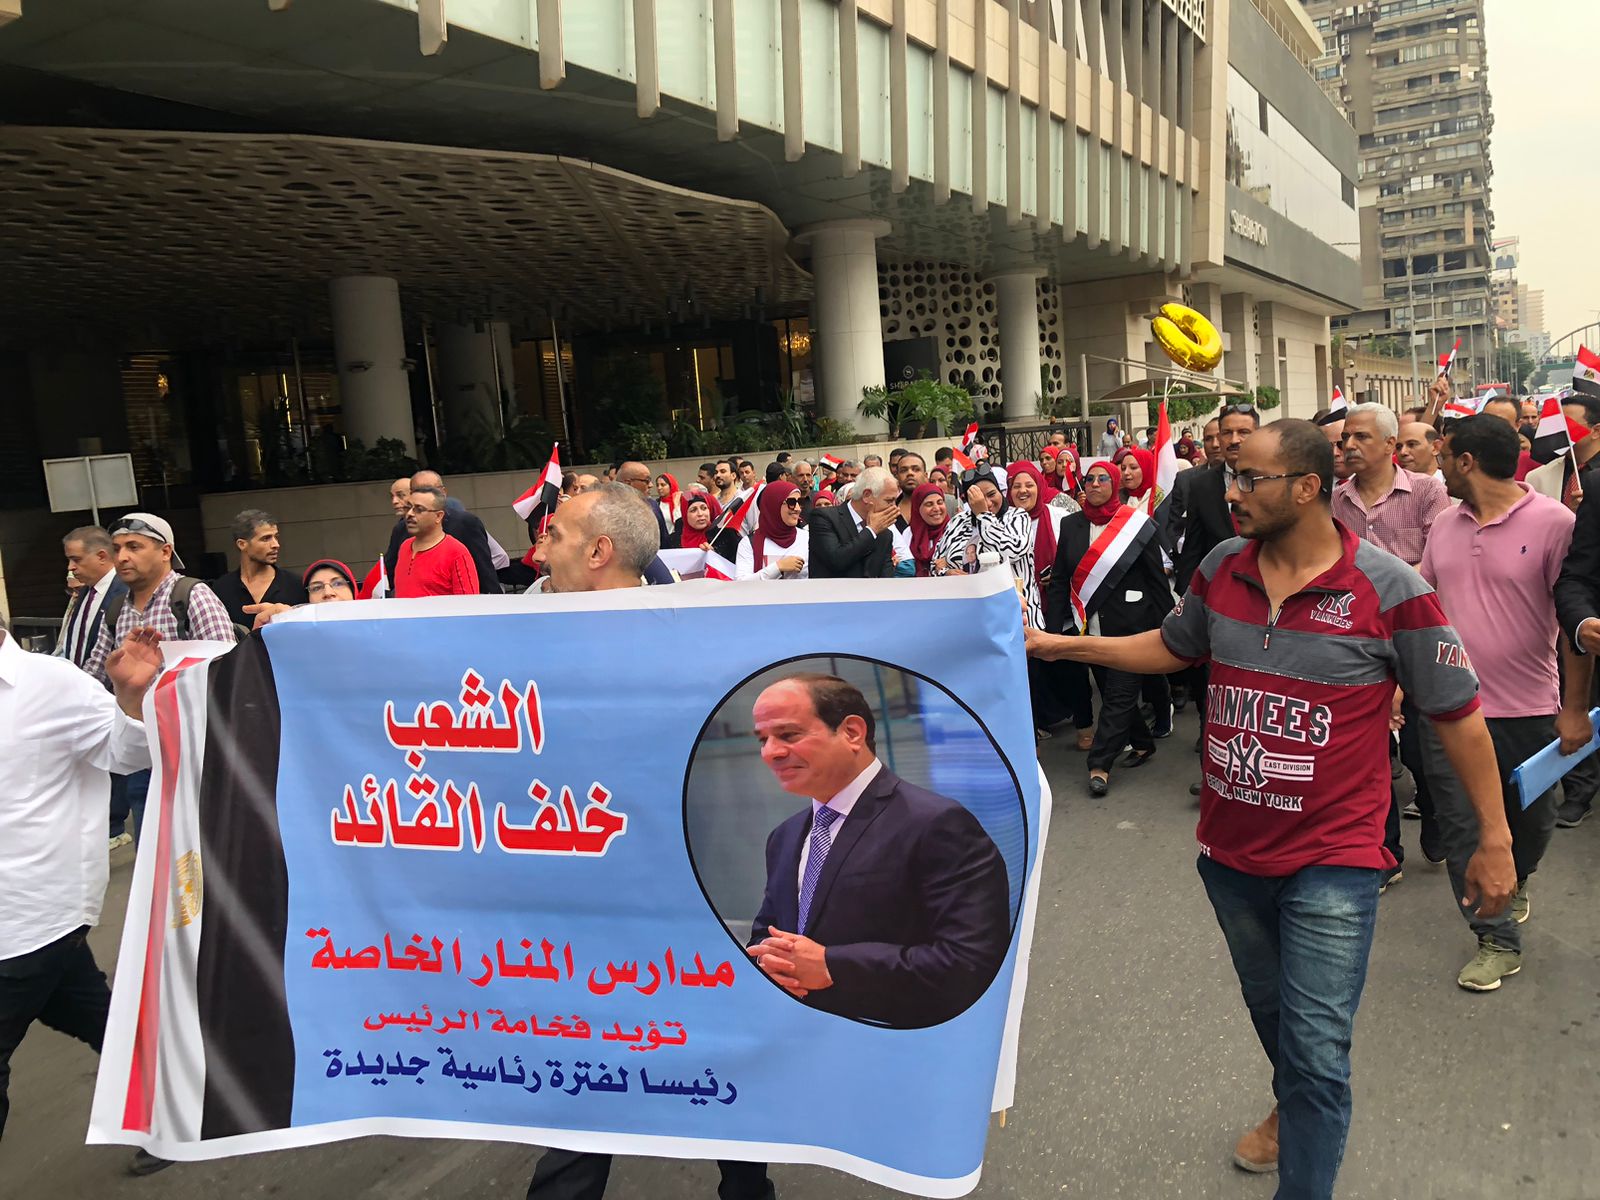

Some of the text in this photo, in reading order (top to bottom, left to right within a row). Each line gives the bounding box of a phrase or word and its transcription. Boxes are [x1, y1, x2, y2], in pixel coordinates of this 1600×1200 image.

[1310, 609, 1354, 630] YANKEES
[1436, 641, 1475, 673] YAN
[384, 667, 545, 771] الشعب
[1207, 684, 1333, 747] YANKEES
[1264, 761, 1312, 772] EAST DIVISION
[330, 773, 629, 858] خلف القائد
[1233, 787, 1262, 805] NEW
[1264, 792, 1304, 812] YORK
[304, 926, 736, 996] مدارس المنار الخاصة
[362, 1003, 689, 1053] تؤيد فخامة الرئيس
[322, 1046, 739, 1107] رئيسا لفترة رئاسية جديدة
